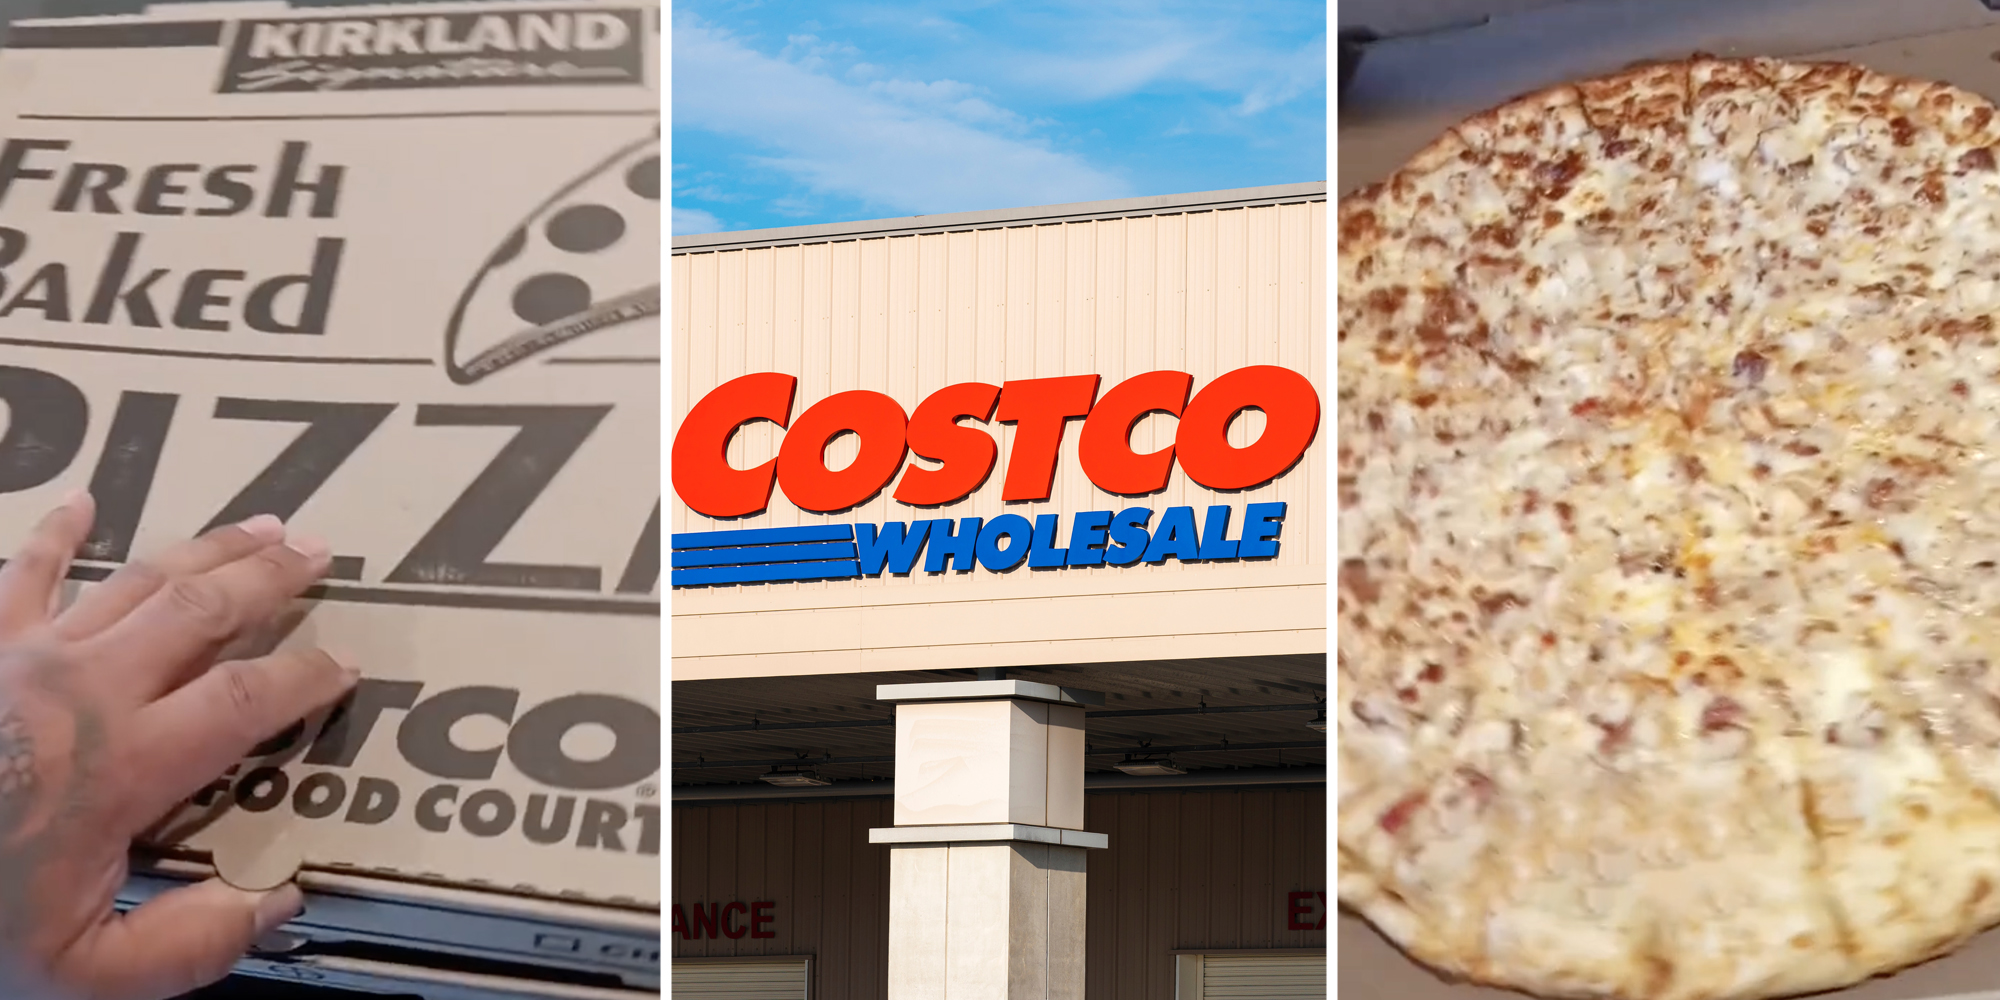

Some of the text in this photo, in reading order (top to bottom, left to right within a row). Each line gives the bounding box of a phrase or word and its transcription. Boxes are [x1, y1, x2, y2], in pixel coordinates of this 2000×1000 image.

[249, 13, 630, 59] KIRKLAND
[671, 364, 1321, 518] COSTCO
[853, 501, 1288, 575] WHOLESALE
[414, 784, 660, 856] COURT
